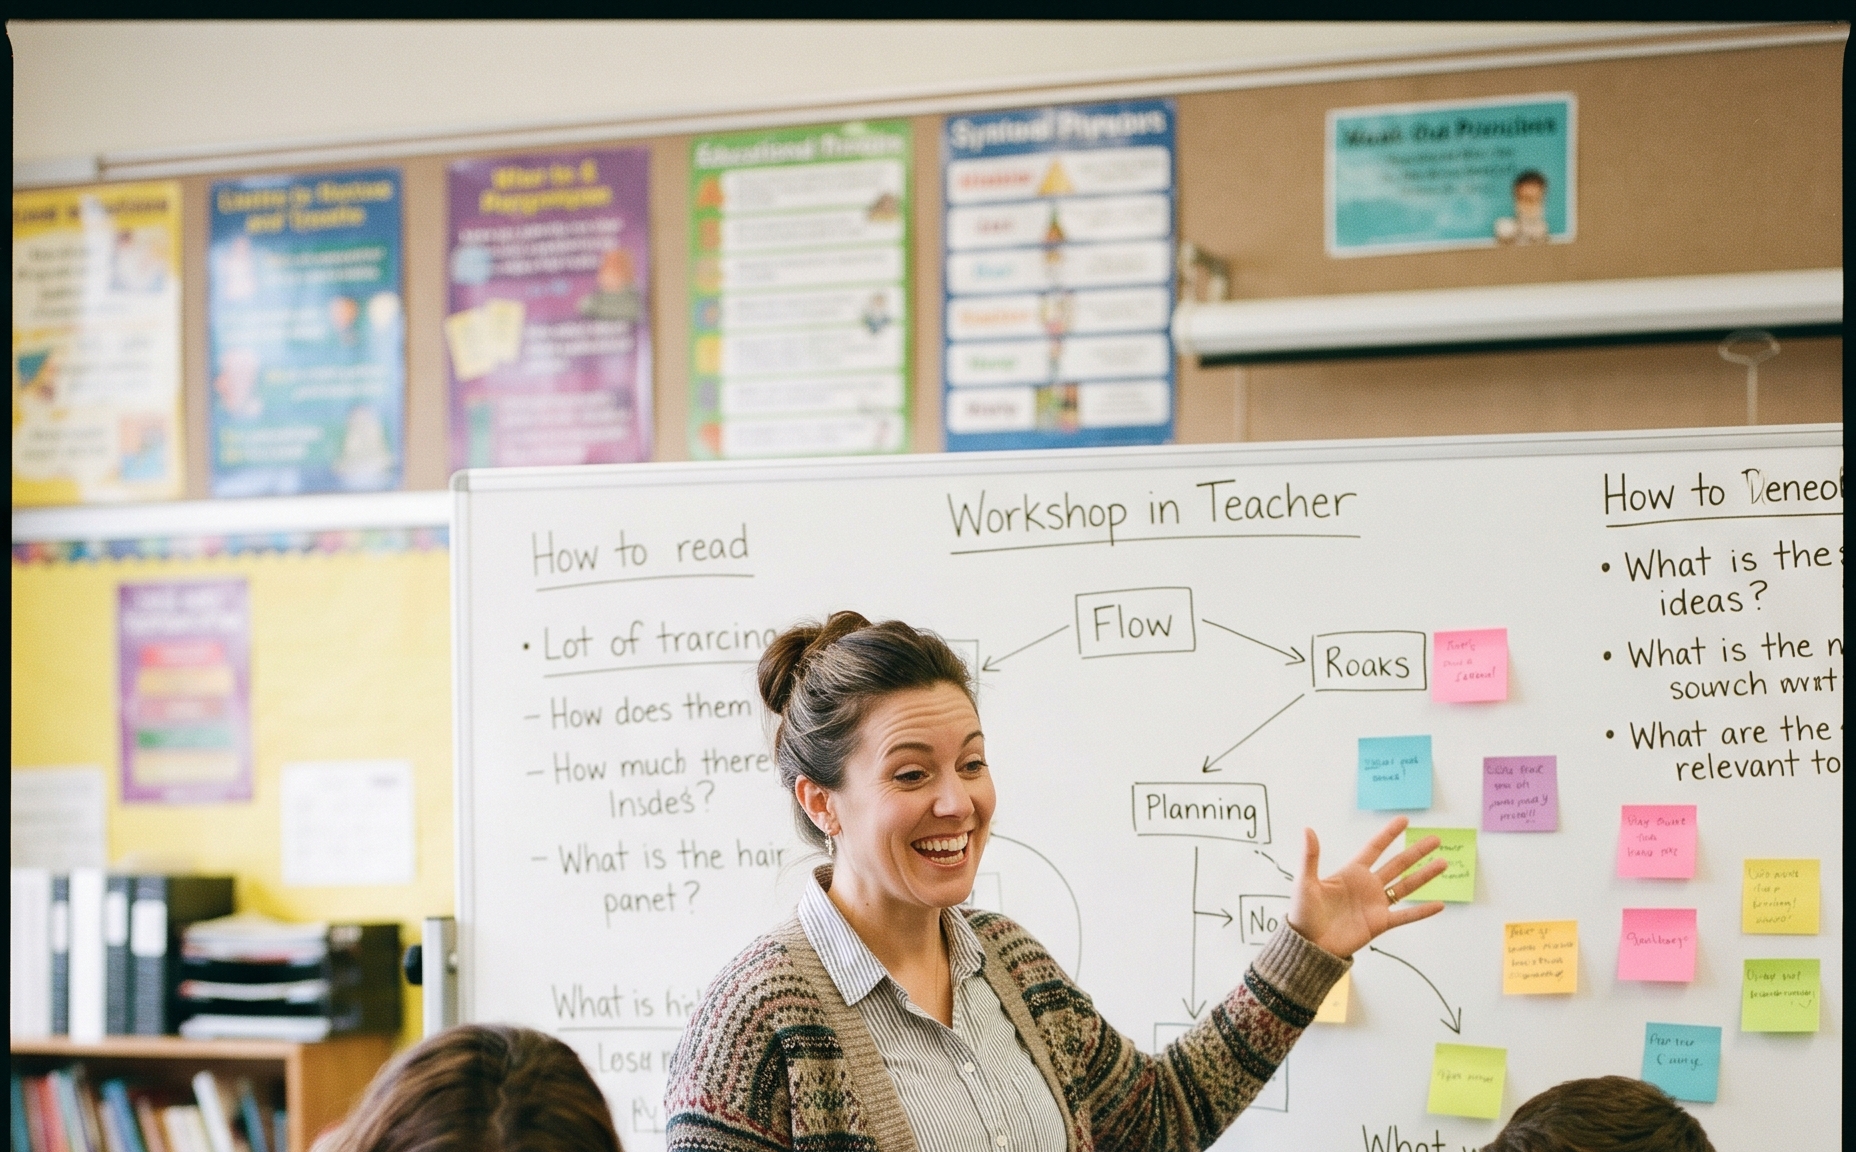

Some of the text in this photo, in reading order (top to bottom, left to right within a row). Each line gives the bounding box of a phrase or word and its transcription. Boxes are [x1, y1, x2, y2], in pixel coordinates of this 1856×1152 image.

[1604, 473, 1675, 515] How
[1691, 472, 1725, 506] to
[947, 479, 1357, 546] Workshop in Teacher
[532, 523, 749, 576] How to read
[1624, 546, 1711, 582] What
[1732, 550, 1757, 573] is
[1773, 540, 1832, 570] the
[1660, 577, 1768, 616] ideas?
[544, 626, 593, 661] Lot
[610, 620, 644, 657] of
[1093, 604, 1172, 641] Flow
[1326, 646, 1410, 679] Roaks
[1628, 637, 1706, 668] What
[1722, 638, 1747, 662] is
[1761, 632, 1813, 660] the
[551, 693, 751, 728] How does them
[1630, 715, 1831, 750] What are the
[554, 749, 768, 784] How much there
[1676, 750, 1840, 781] relevant to
[1146, 793, 1257, 839] Planning
[559, 842, 628, 874] What
[644, 845, 667, 870] is
[678, 840, 723, 869] the
[552, 985, 623, 1019] What
[634, 990, 654, 1017] is
